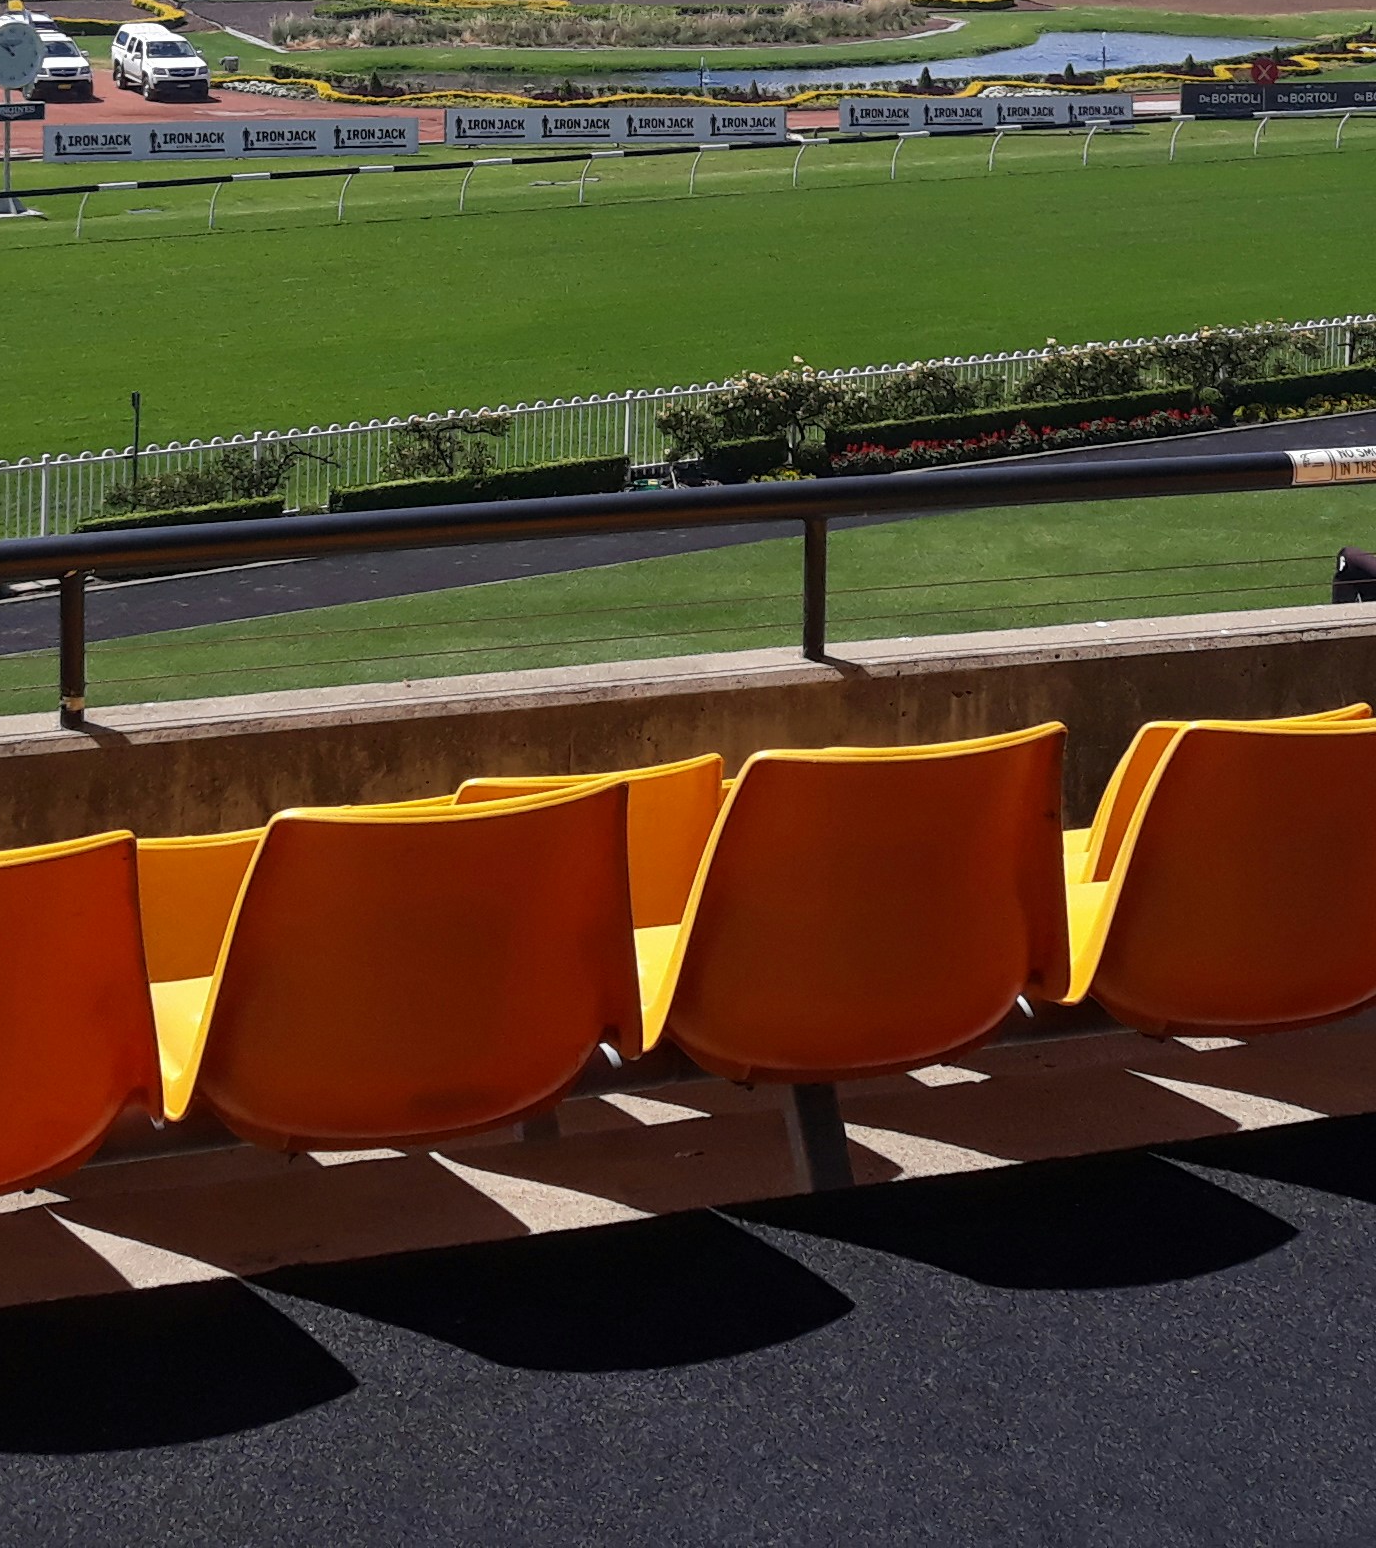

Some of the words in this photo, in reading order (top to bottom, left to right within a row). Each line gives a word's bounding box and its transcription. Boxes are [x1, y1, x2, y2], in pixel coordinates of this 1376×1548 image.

[1211, 93, 1261, 104] BORTOLI
[1289, 92, 1337, 103] BORTOLI
[859, 108, 883, 119] IRON
[884, 107, 910, 118] JACK
[934, 107, 957, 118] IRON
[958, 107, 983, 118] JACK
[1006, 107, 1029, 117] IRON
[1030, 106, 1055, 117] JACK
[1078, 106, 1100, 117] IRON
[1101, 105, 1125, 116] JACK
[467, 120, 496, 131] IRON
[496, 119, 525, 130] JACK
[554, 119, 582, 130] IRON
[583, 118, 611, 130] JACK
[638, 118, 666, 129] IRON
[667, 117, 695, 129] JACK
[721, 117, 749, 128] IRON
[750, 116, 777, 128] JACK
[67, 135, 99, 147] IRON
[100, 133, 132, 146] JACK
[162, 132, 194, 145] IRON
[195, 131, 225, 144] JACK
[255, 131, 286, 143] IRON
[287, 130, 317, 142] JACK
[346, 129, 376, 141] IRON
[377, 128, 407, 140] JACK
[1336, 448, 1354, 459] NO
[1340, 461, 1351, 476] IN
